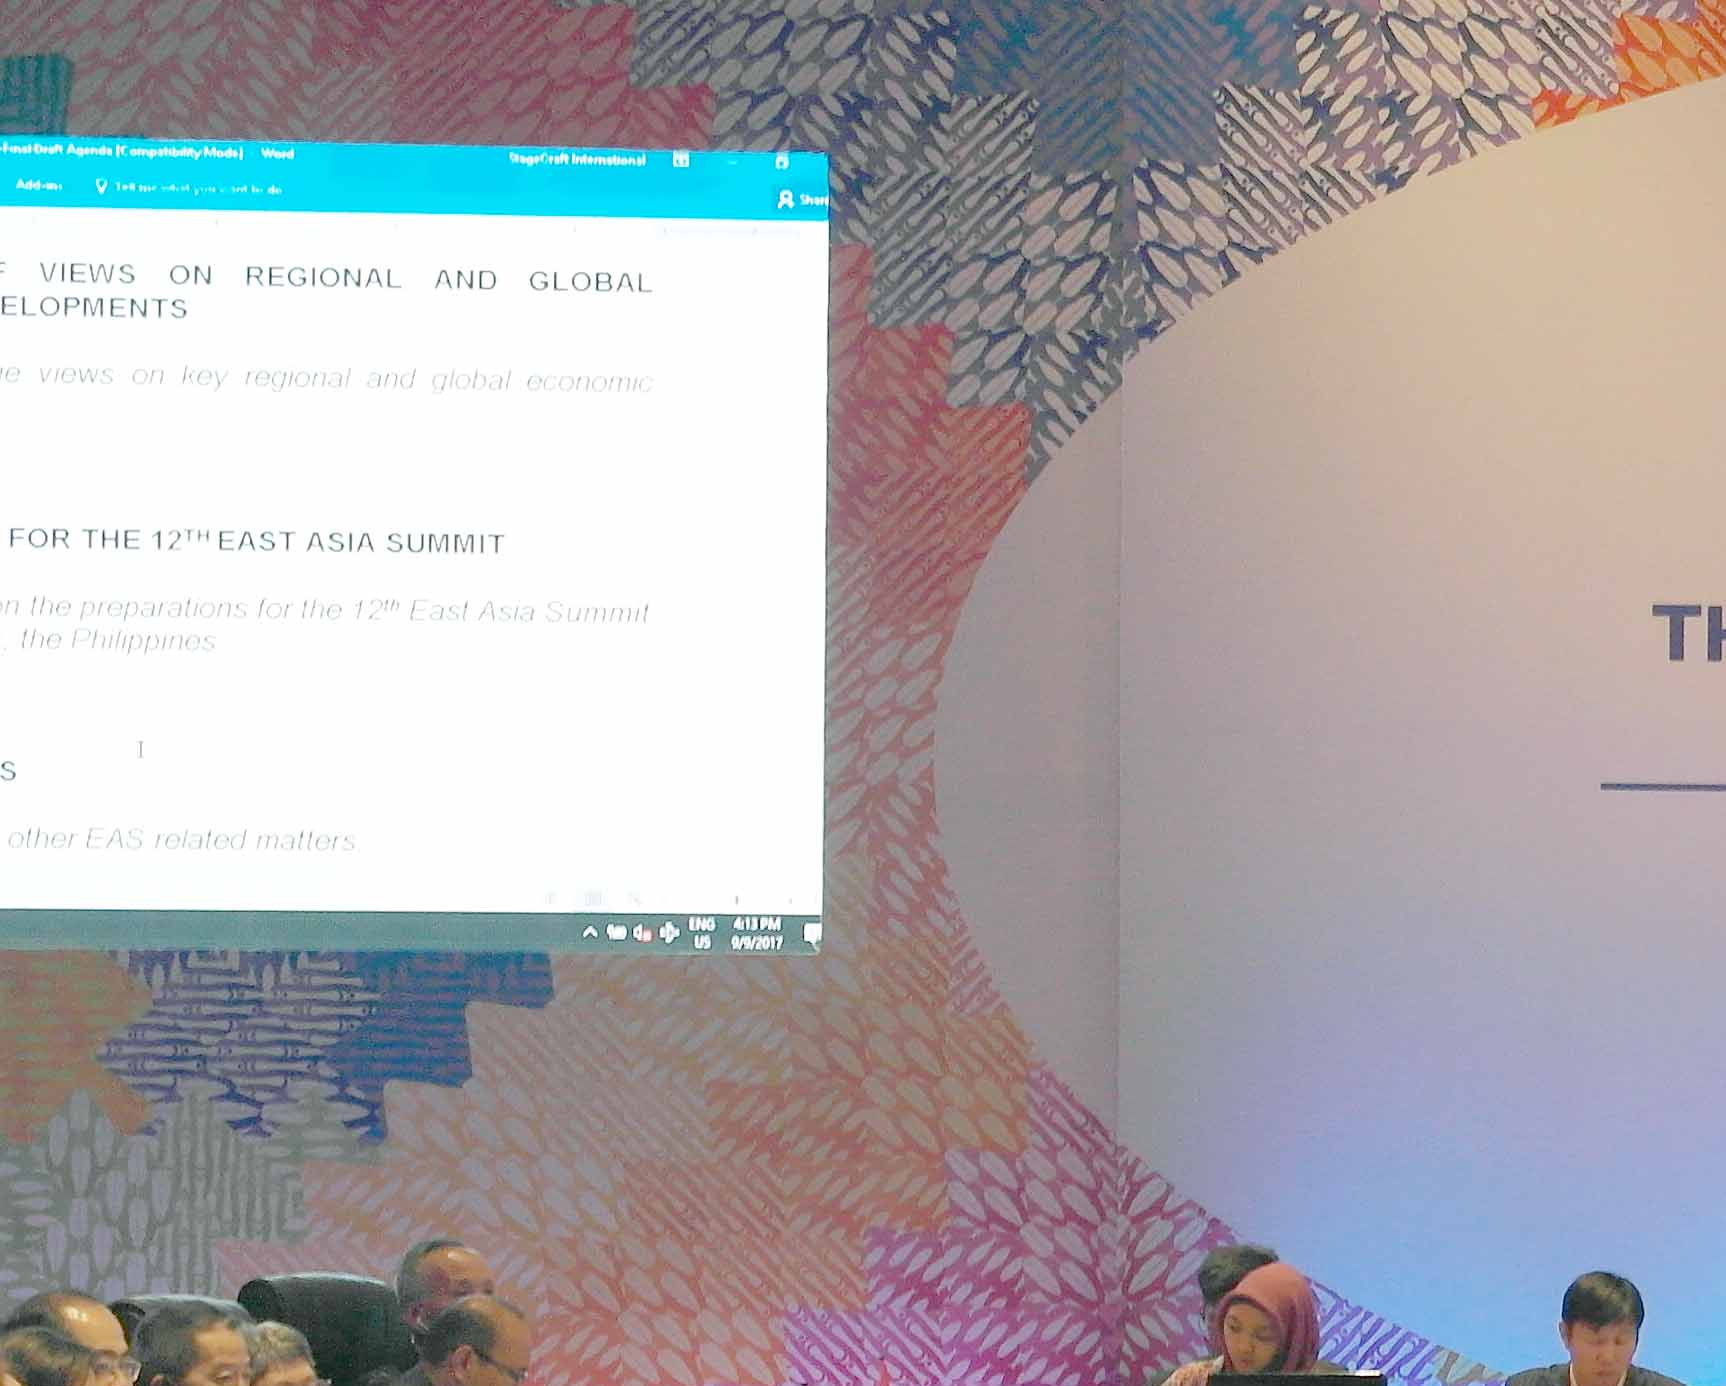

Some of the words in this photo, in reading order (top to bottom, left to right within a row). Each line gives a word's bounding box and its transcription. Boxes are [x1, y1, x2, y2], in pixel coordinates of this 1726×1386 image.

[66, 143, 113, 160] Agenda
[261, 147, 295, 160] Word
[40, 263, 135, 283] VIEWS
[170, 265, 211, 284] ON
[247, 267, 401, 288] REGIONAL
[435, 270, 496, 289] AND
[530, 272, 651, 292] GLOBAL
[40, 368, 113, 384] views
[132, 369, 164, 384] on
[182, 366, 228, 389] key
[245, 369, 351, 391] regional
[367, 369, 416, 388] and
[432, 369, 511, 391] global
[527, 375, 653, 393] economic
[10, 528, 69, 548] FOR
[83, 529, 139, 549] THE
[152, 530, 209, 549] 12TH
[219, 531, 295, 550] EAST
[307, 532, 374, 552] ASIA
[387, 534, 504, 552] SUMMIT
[31, 596, 71, 616] the
[80, 599, 246, 620] preparations
[258, 598, 293, 618] for
[302, 600, 342, 619] the
[355, 600, 400, 620] 12th
[410, 600, 468, 620] East
[478, 601, 535, 621] Asia
[546, 602, 648, 622] Summit
[22, 629, 62, 648] the
[72, 629, 214, 653] Philippines
[8, 828, 74, 848] other
[86, 828, 143, 848] EAS
[155, 829, 247, 849] related
[689, 916, 717, 932] ENG
[760, 917, 781, 931] PM
[694, 935, 711, 950] US
[731, 935, 784, 951] 9/9/2017
